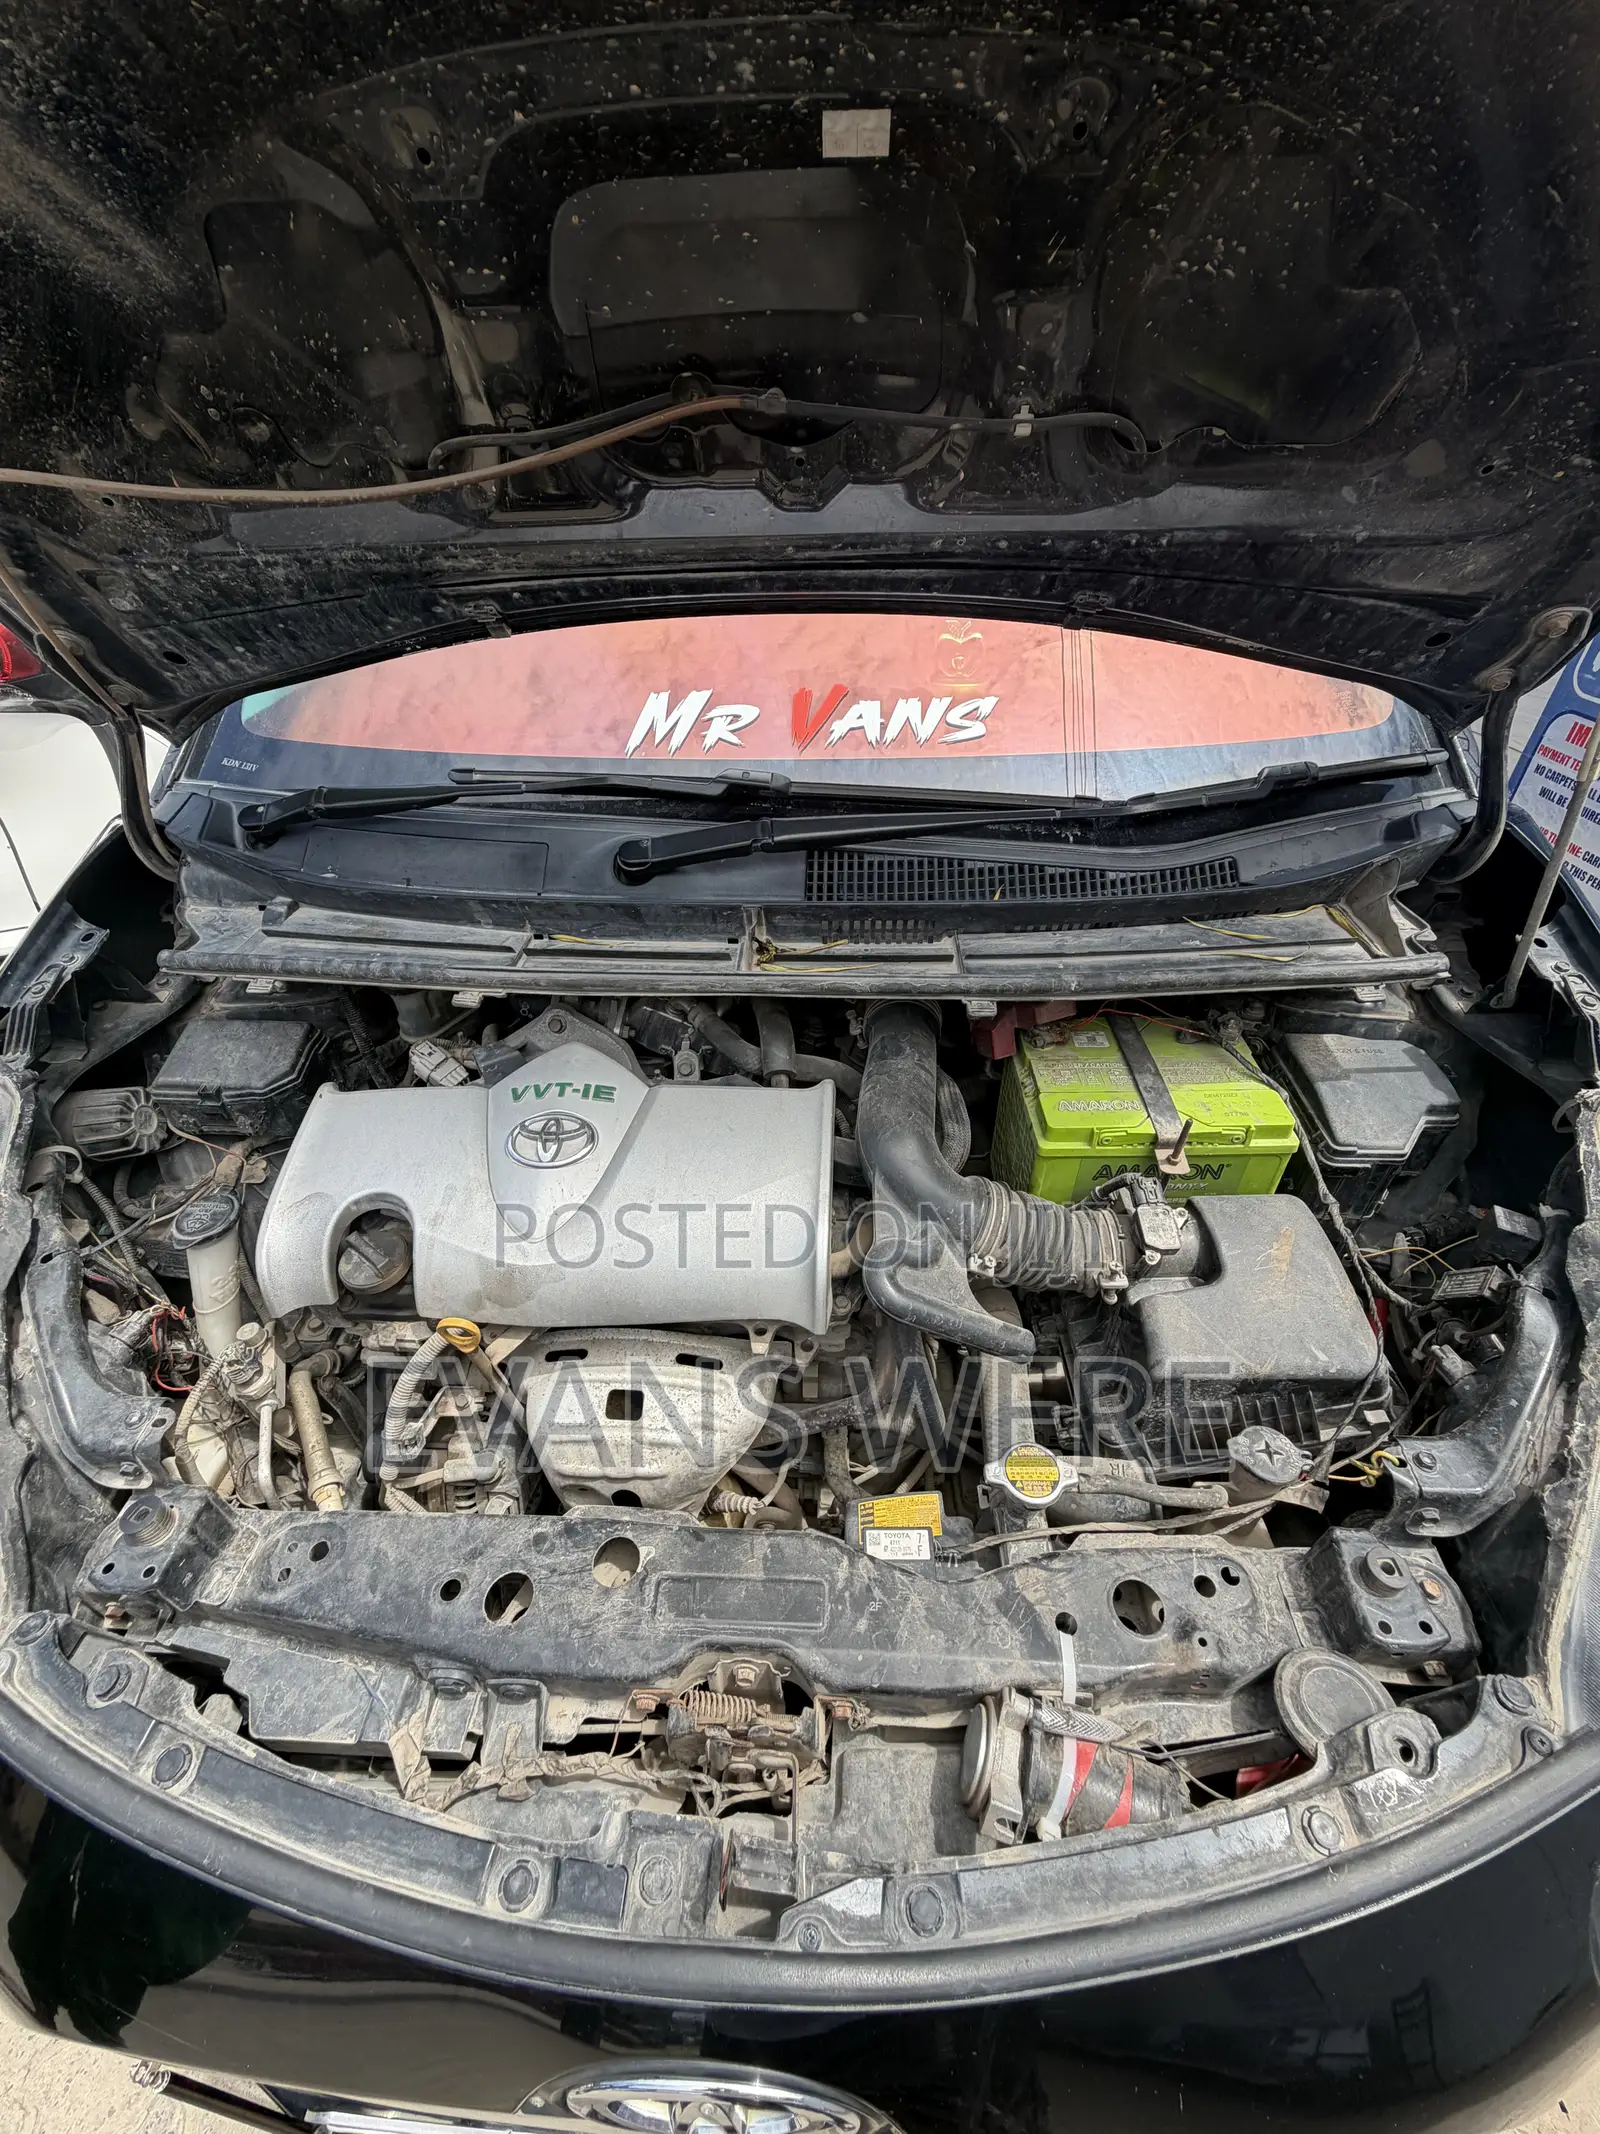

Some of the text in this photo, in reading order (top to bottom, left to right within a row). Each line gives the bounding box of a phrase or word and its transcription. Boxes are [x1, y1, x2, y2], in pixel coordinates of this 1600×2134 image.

[221, 757, 241, 768] KDN
[1537, 744, 1572, 766] PAYMENT
[1533, 763, 1546, 777] NO
[1545, 768, 1579, 792] CARPETS
[1538, 785, 1558, 803] WILL
[1555, 794, 1569, 808] BE
[1569, 863, 1588, 882] THIS
[511, 1082, 617, 1103] VVT-IE
[1059, 1099, 1142, 1112] AMARON
[1092, 1163, 1226, 1181] AMAON
[869, 1601, 883, 1611] 2F
